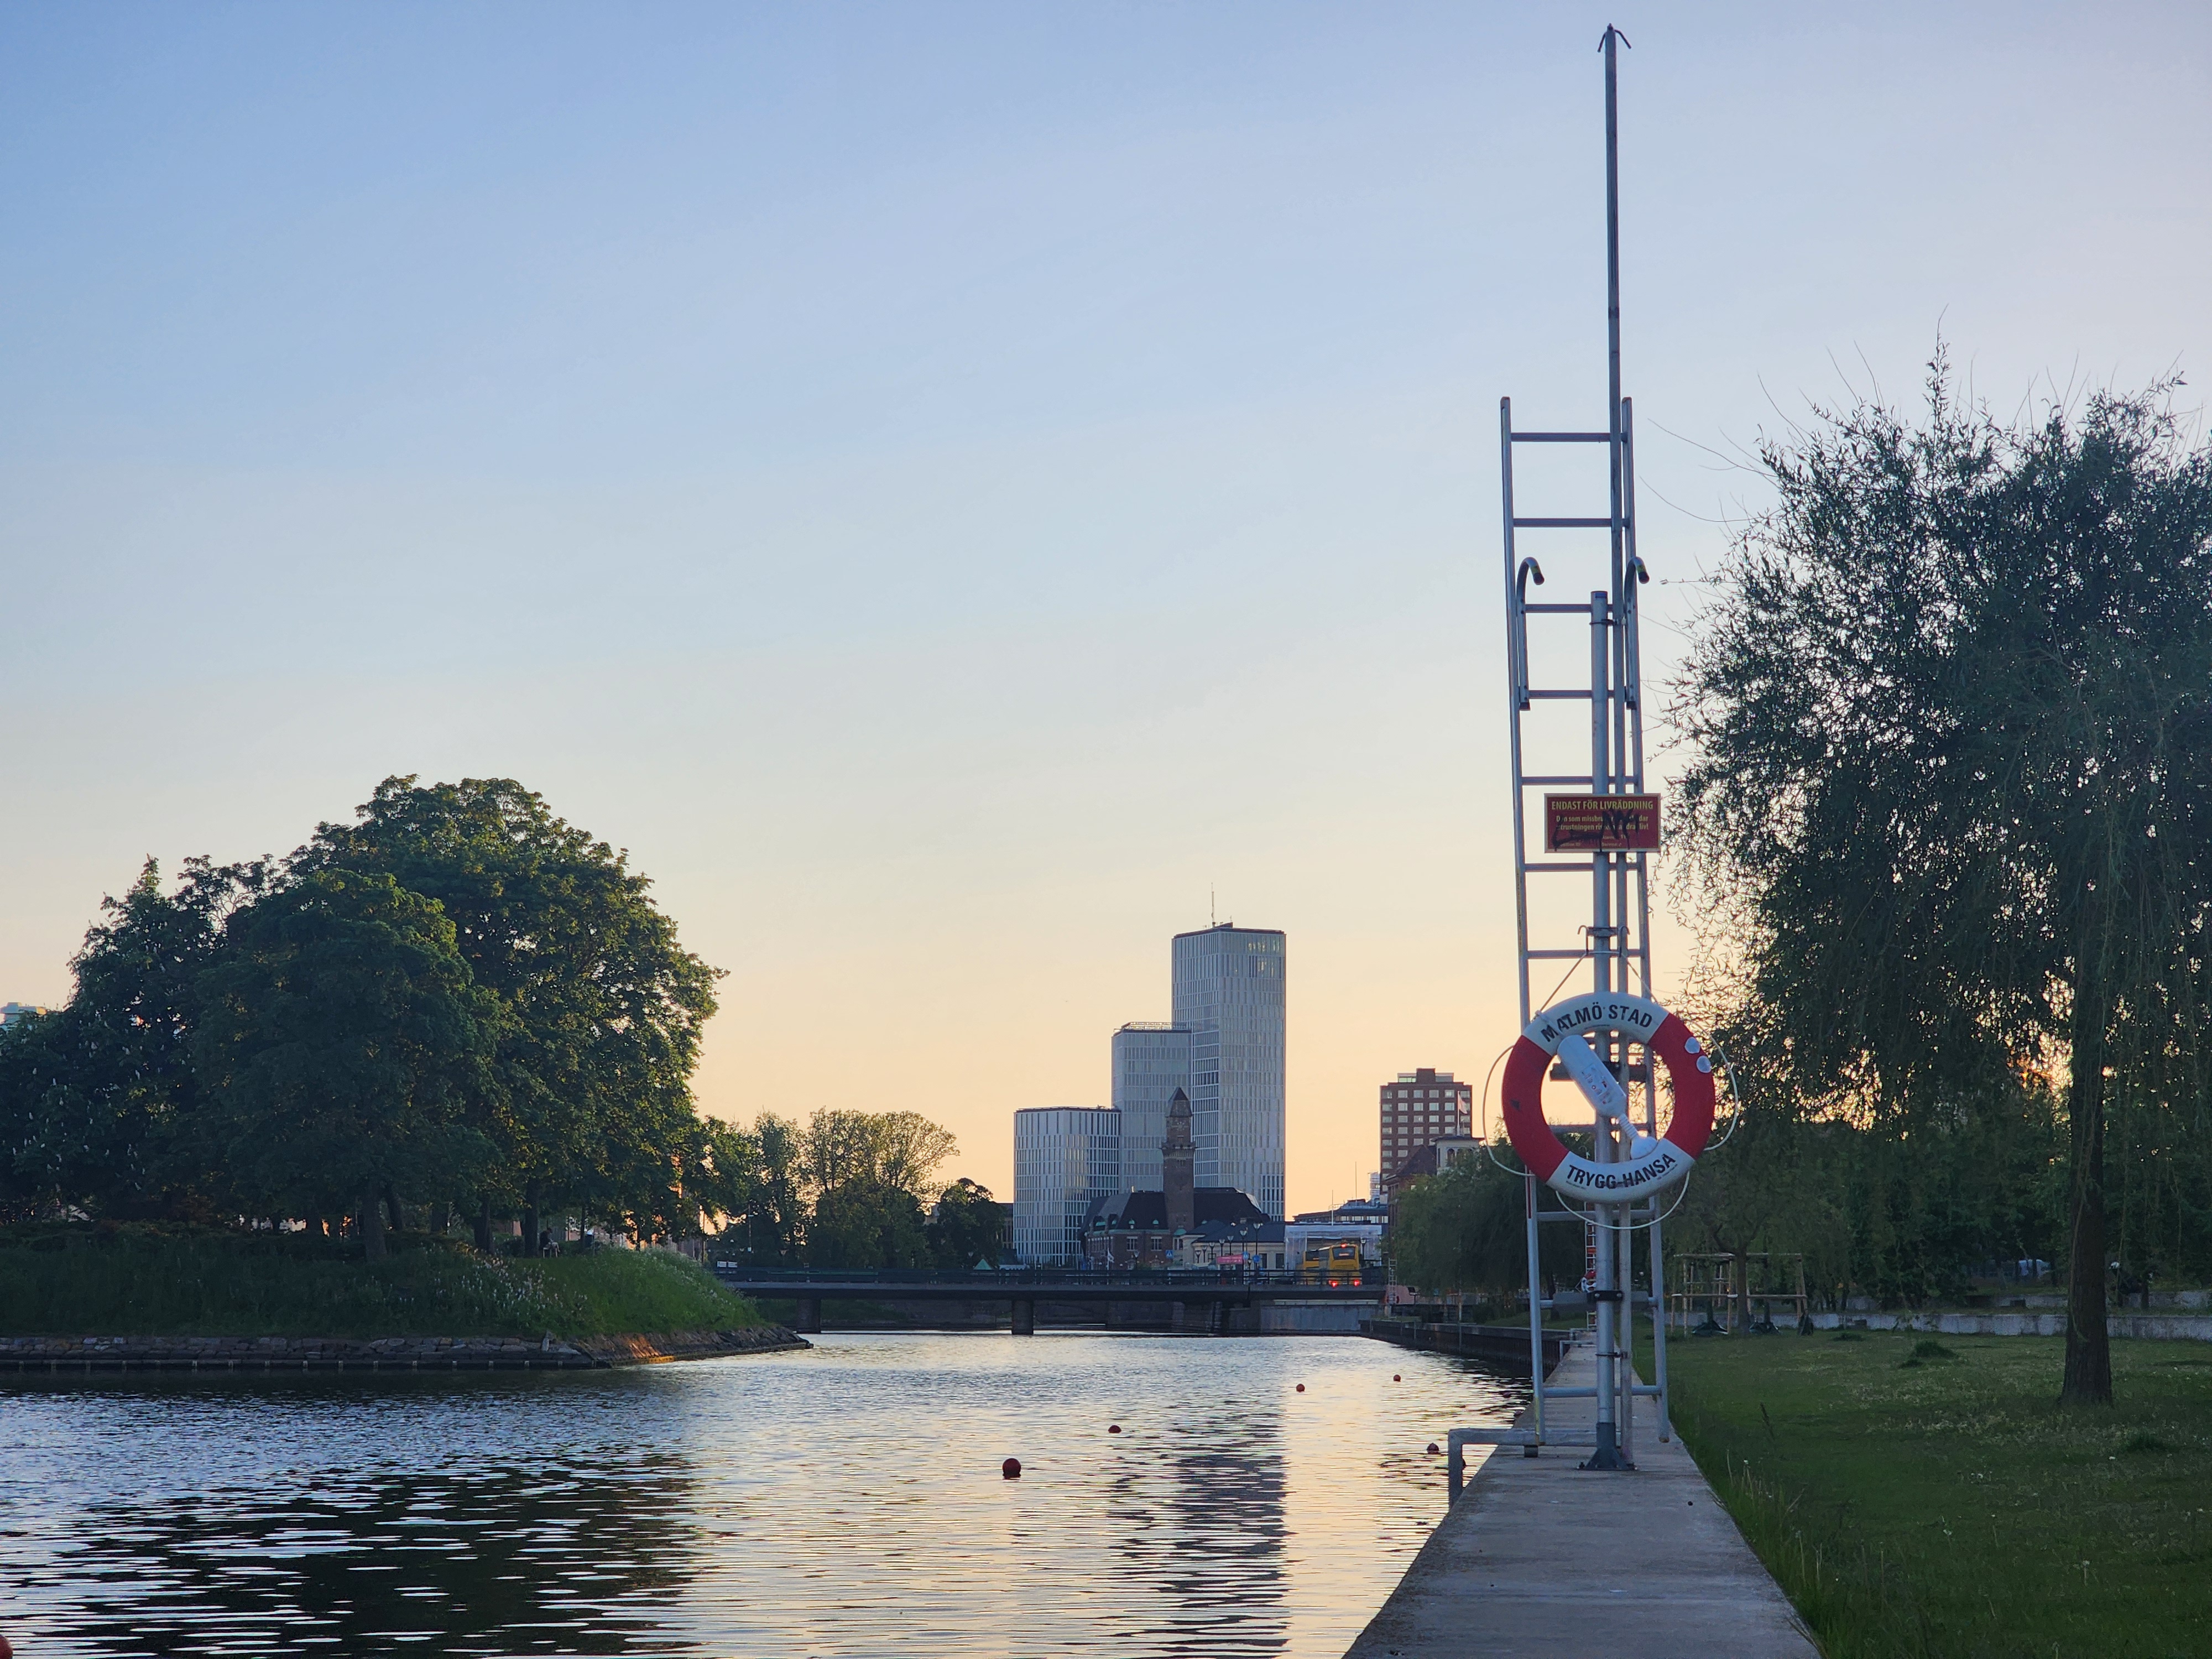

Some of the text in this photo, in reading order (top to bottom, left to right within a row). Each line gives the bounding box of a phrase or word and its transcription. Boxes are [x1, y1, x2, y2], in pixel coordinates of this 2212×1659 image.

[1551, 800, 1653, 810] ENDAST FÖR LIVRÄDDNING
[1556, 823, 1594, 831] trustningen
[1540, 1001, 1652, 1042] MALMÖ STAD
[1567, 1153, 1676, 1189] TRYGG-HANSA
